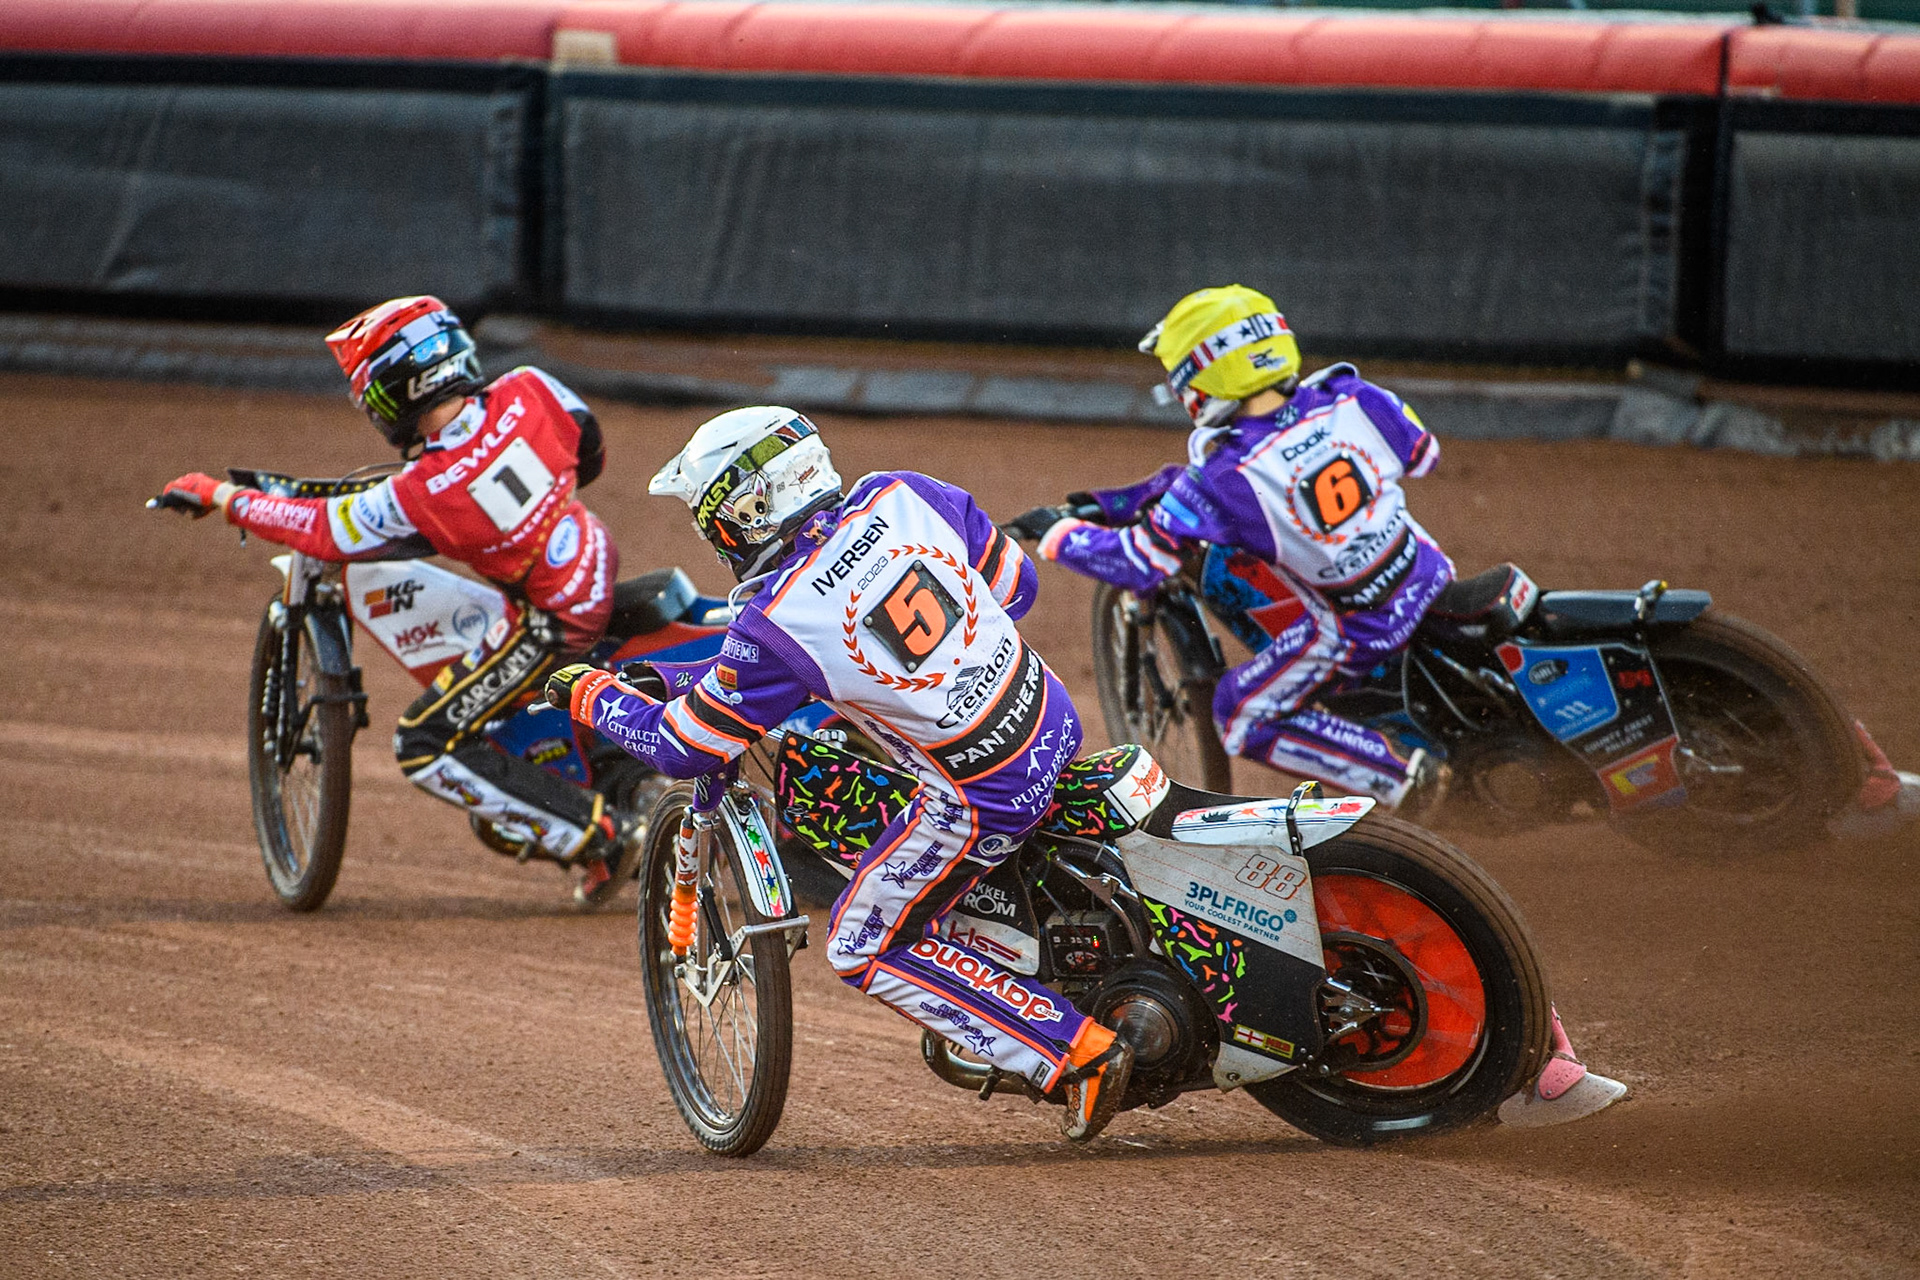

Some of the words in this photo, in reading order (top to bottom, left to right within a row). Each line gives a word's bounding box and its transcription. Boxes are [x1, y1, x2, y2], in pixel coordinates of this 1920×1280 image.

[424, 395, 527, 496] BEWLEY
[1281, 424, 1332, 462] COOK
[491, 464, 533, 509] 1
[1314, 459, 1361, 525] 6
[810, 514, 890, 597] IVERSEN
[857, 554, 889, 592] 2023
[883, 569, 948, 657] 5
[935, 636, 1013, 730] Crendon
[946, 651, 1042, 770] PANTHERS
[623, 740, 658, 757] GROUP
[1010, 714, 1075, 812] PURPLEROCK
[977, 882, 1008, 902] KKEL
[1235, 852, 1307, 900] 88
[962, 893, 1017, 918] ROM
[1184, 898, 1206, 914] YOUR
[1207, 908, 1241, 928] COOLEST
[1243, 921, 1281, 943] PARTNER
[1186, 881, 1284, 932] 3PLFRIGO
[909, 939, 1058, 1023] daytona
